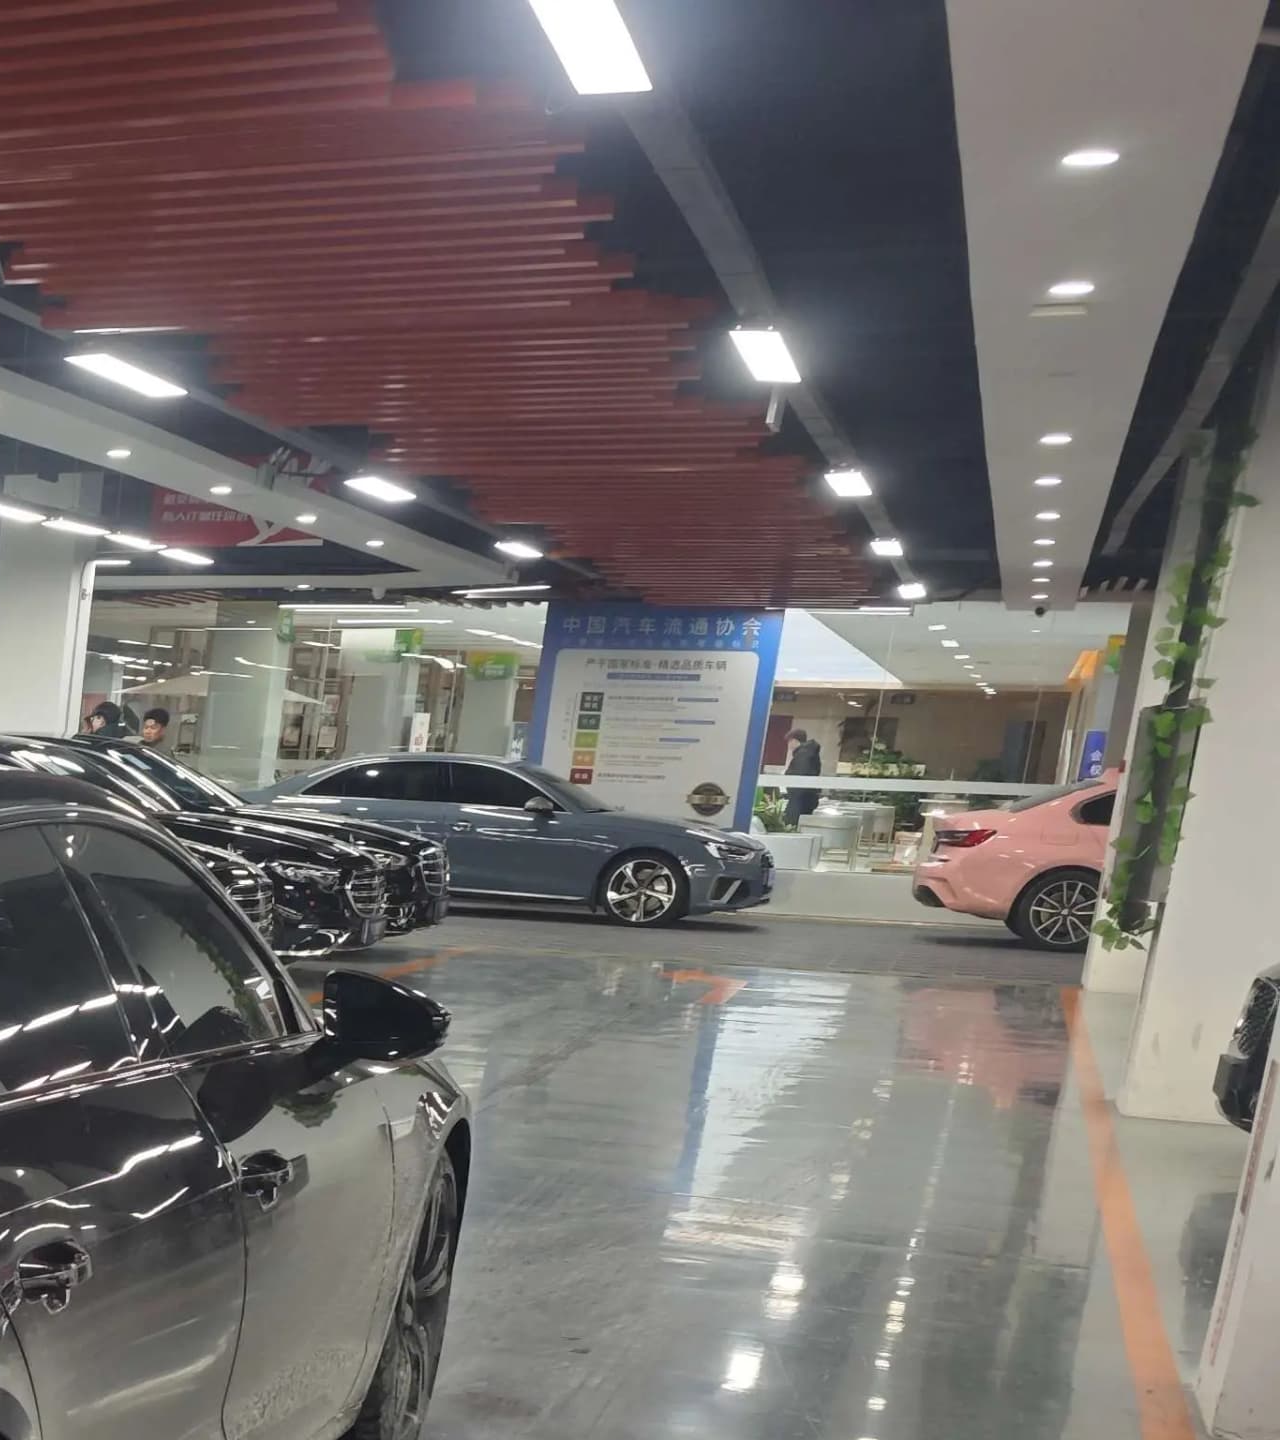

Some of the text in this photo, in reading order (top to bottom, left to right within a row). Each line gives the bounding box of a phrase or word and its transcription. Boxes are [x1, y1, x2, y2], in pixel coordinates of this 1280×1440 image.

[562, 615, 762, 637] 中国汽车流通协会
